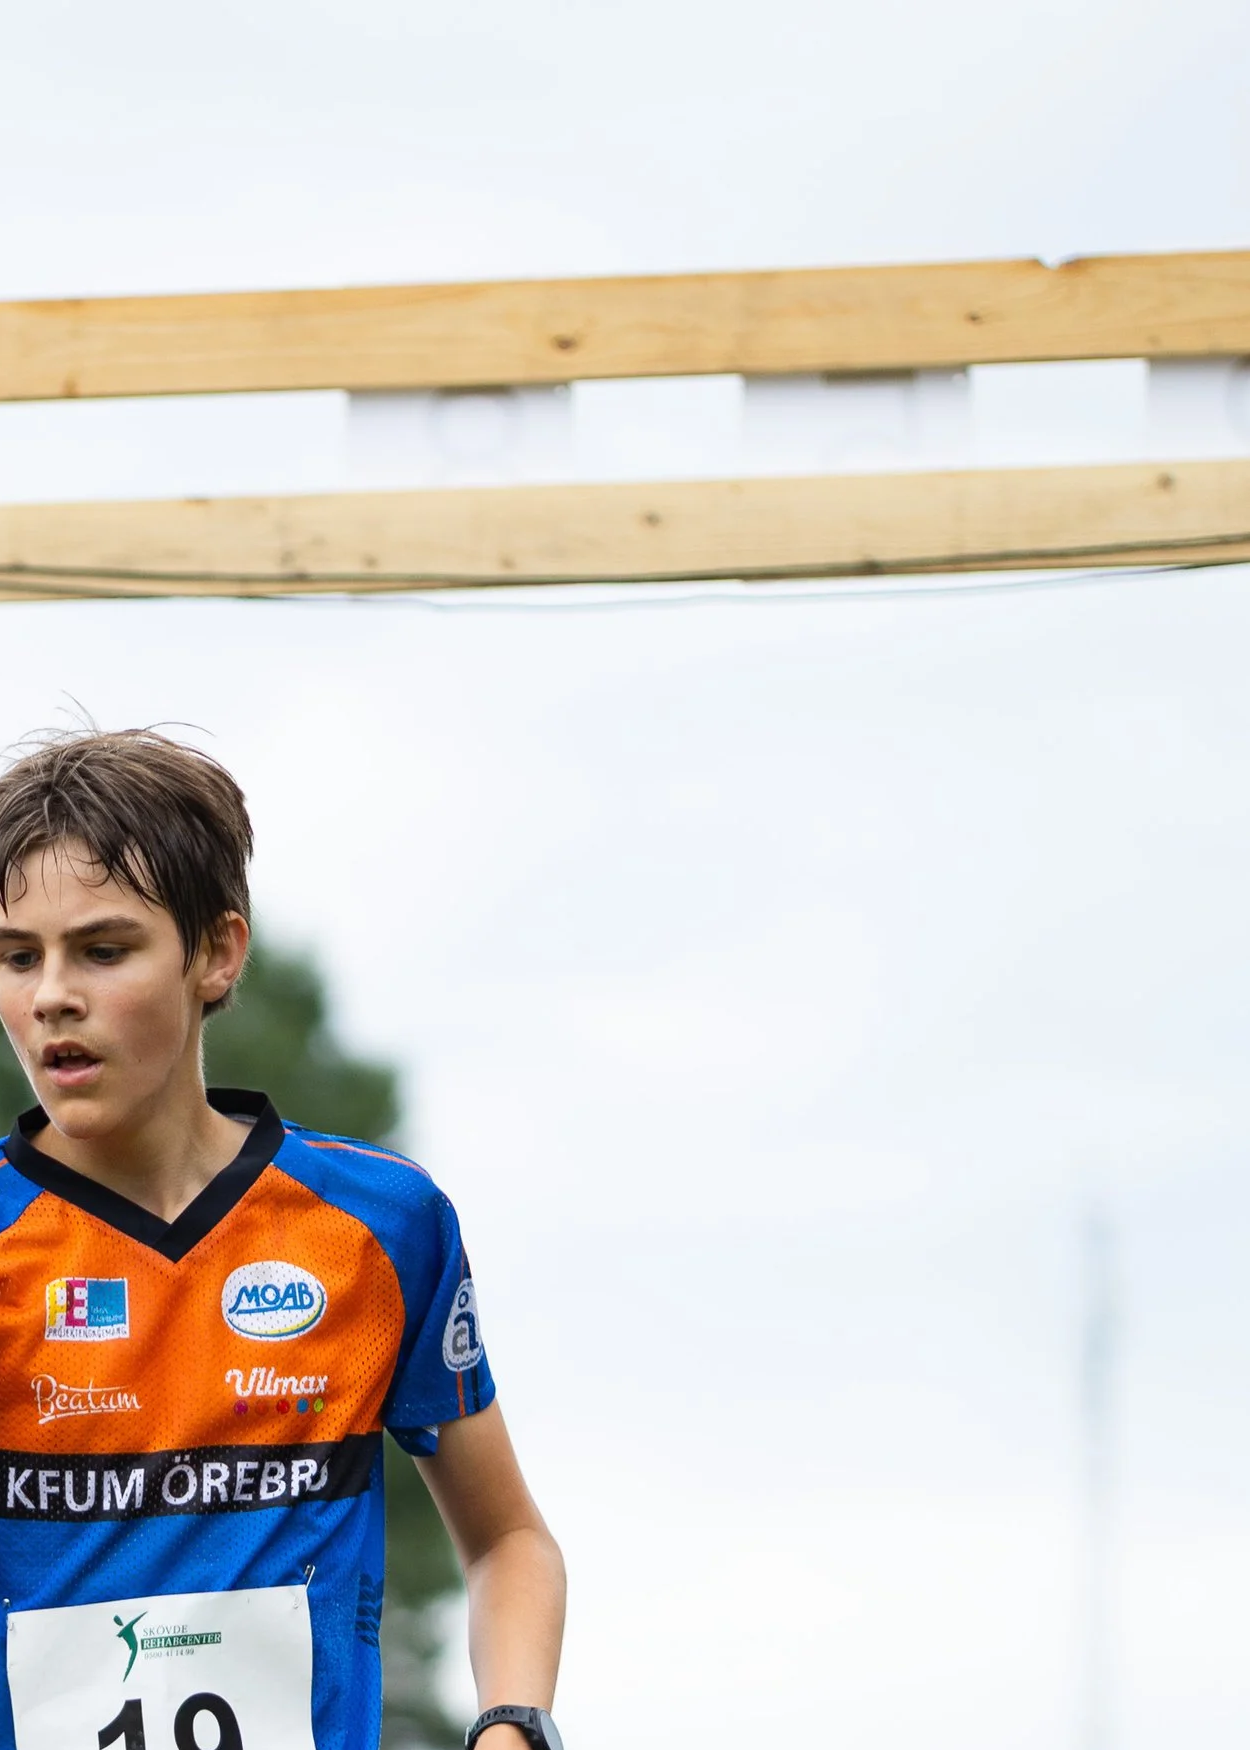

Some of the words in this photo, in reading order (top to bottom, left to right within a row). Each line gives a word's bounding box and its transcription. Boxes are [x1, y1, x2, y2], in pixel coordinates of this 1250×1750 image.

[228, 1282, 315, 1314] MOAB
[6, 1466, 146, 1512] KFUM
[143, 1624, 188, 1637] SKÖVDE
[143, 1633, 221, 1649] REHABCENTER
